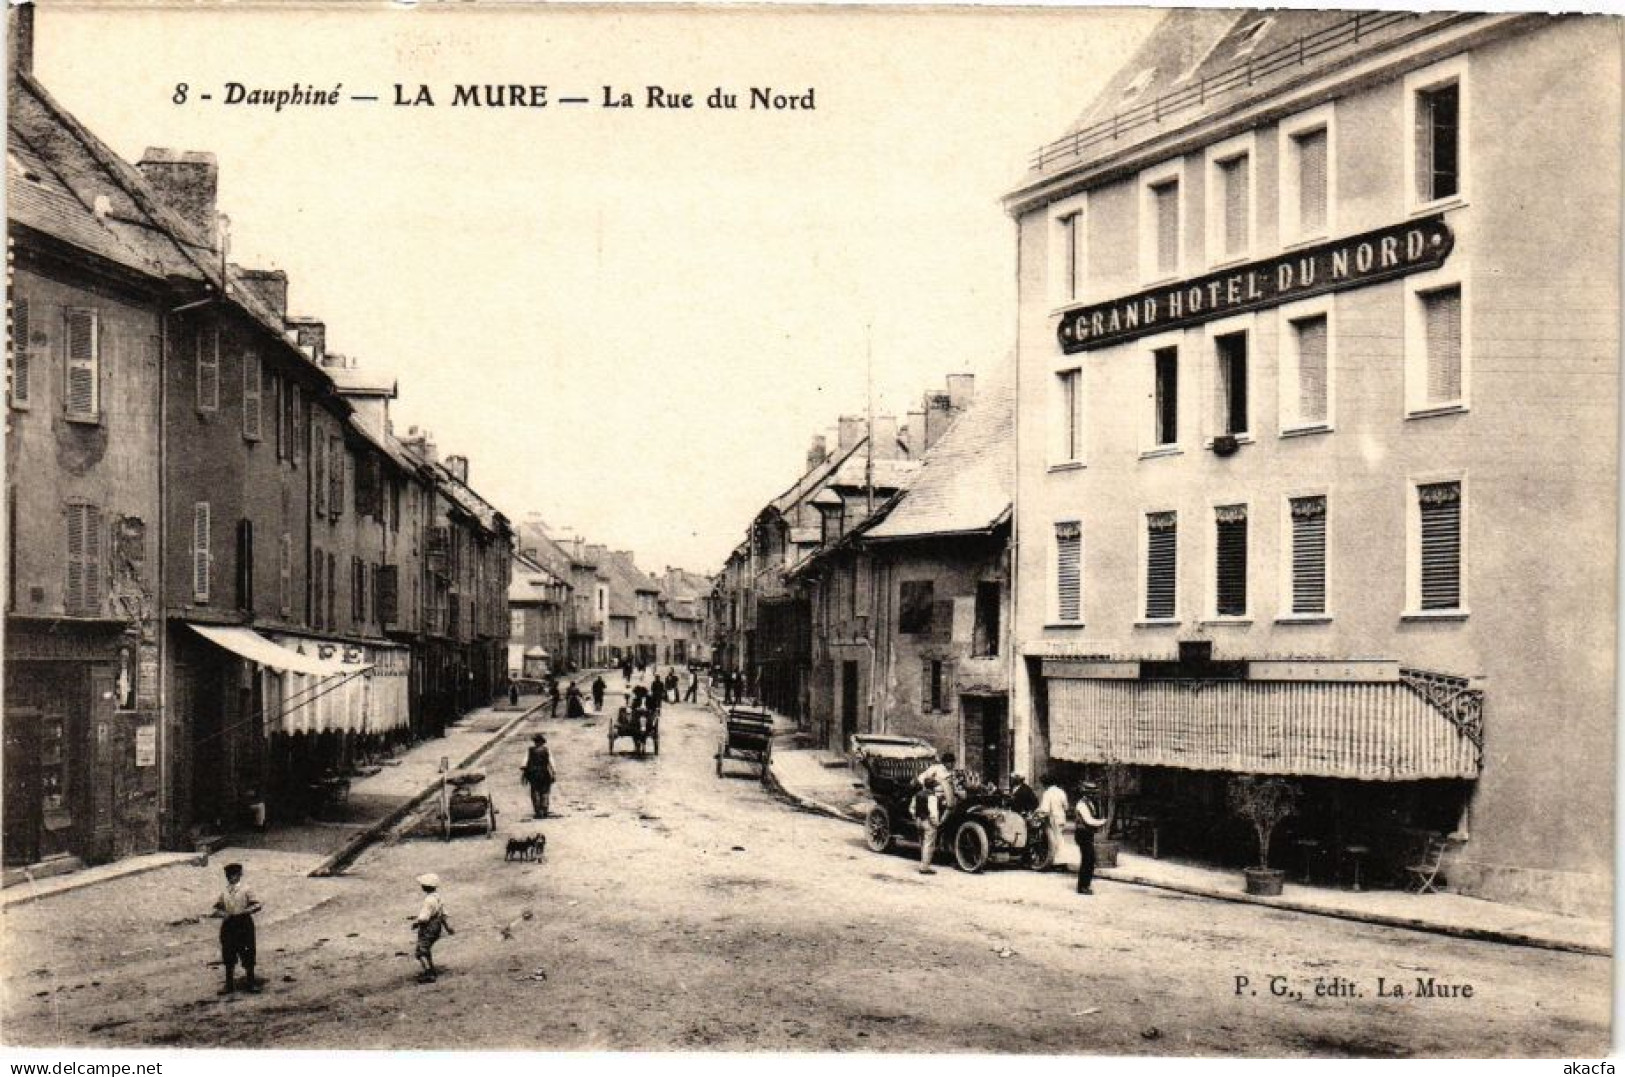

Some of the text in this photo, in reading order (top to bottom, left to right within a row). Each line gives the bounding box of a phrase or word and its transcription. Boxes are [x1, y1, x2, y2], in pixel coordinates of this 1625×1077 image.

[1074, 230, 1425, 341] GRAND HOTEL DU NORD
